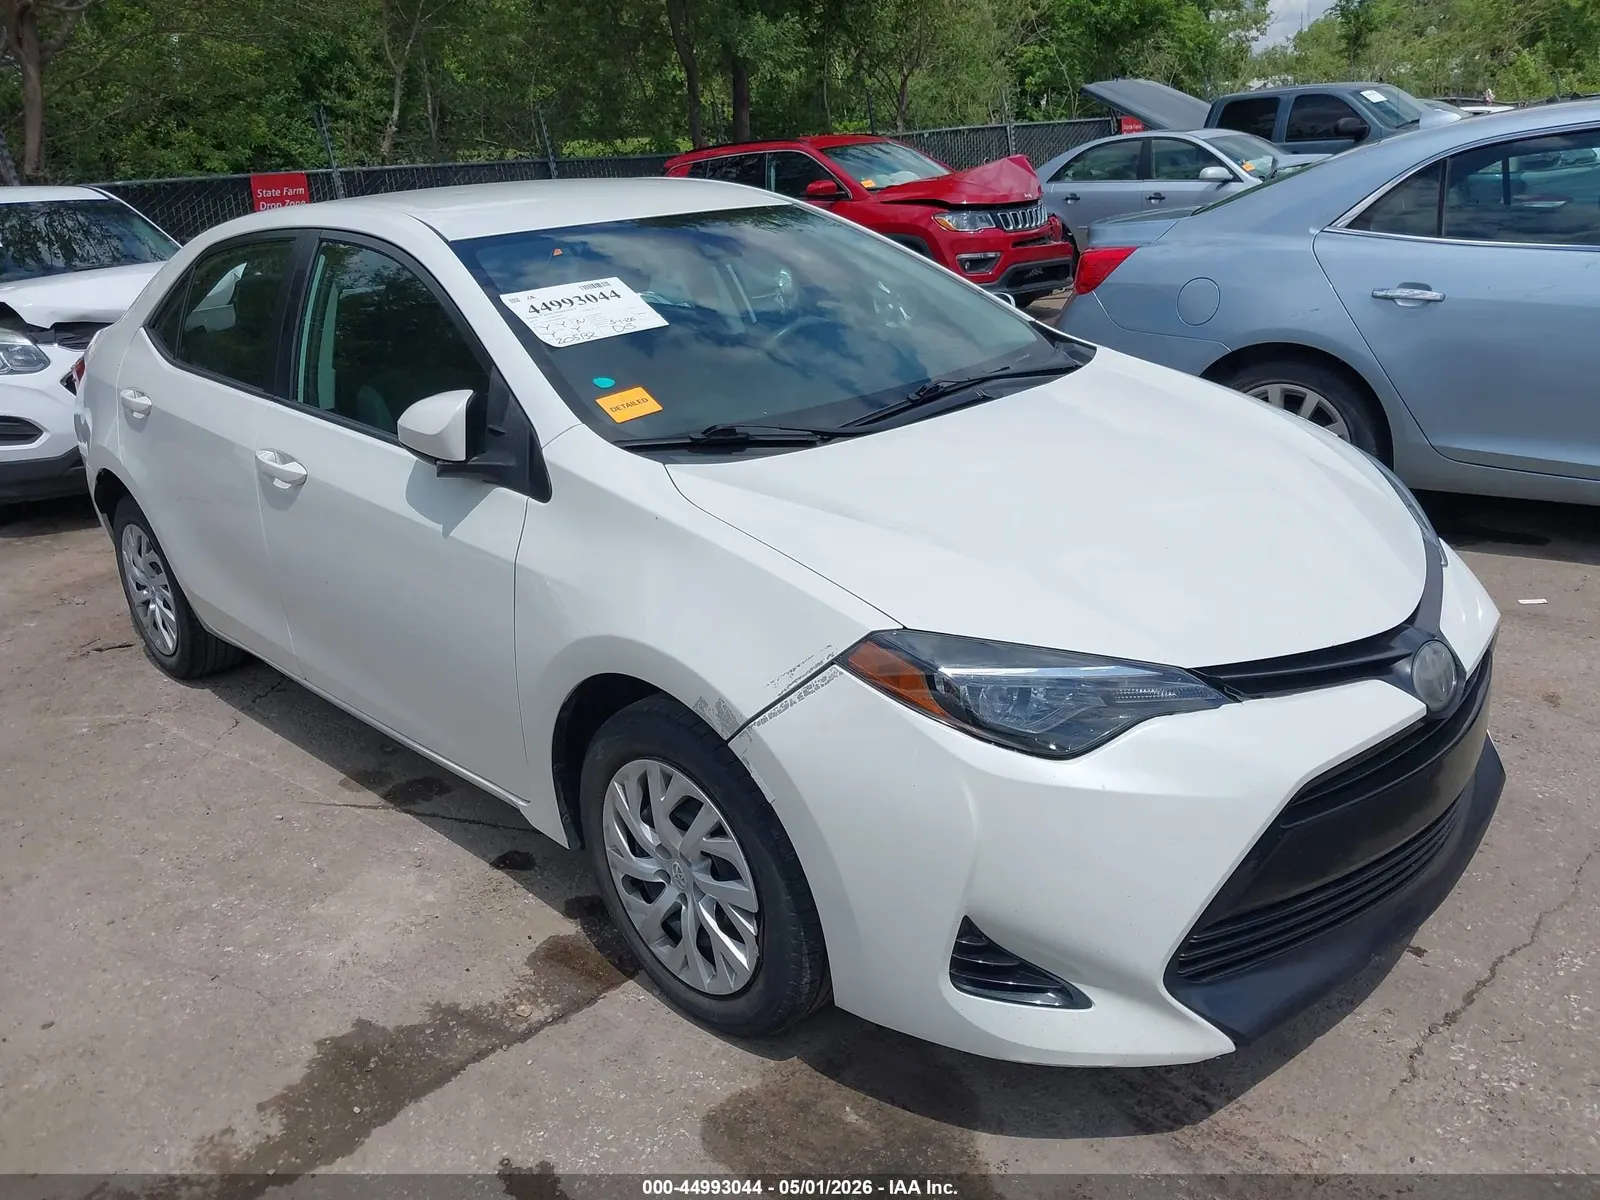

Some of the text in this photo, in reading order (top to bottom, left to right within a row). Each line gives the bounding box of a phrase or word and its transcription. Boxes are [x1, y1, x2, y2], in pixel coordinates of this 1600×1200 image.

[257, 187, 305, 198] State Farm
[528, 289, 622, 315] 44993044
[609, 397, 649, 413] DETAILED
